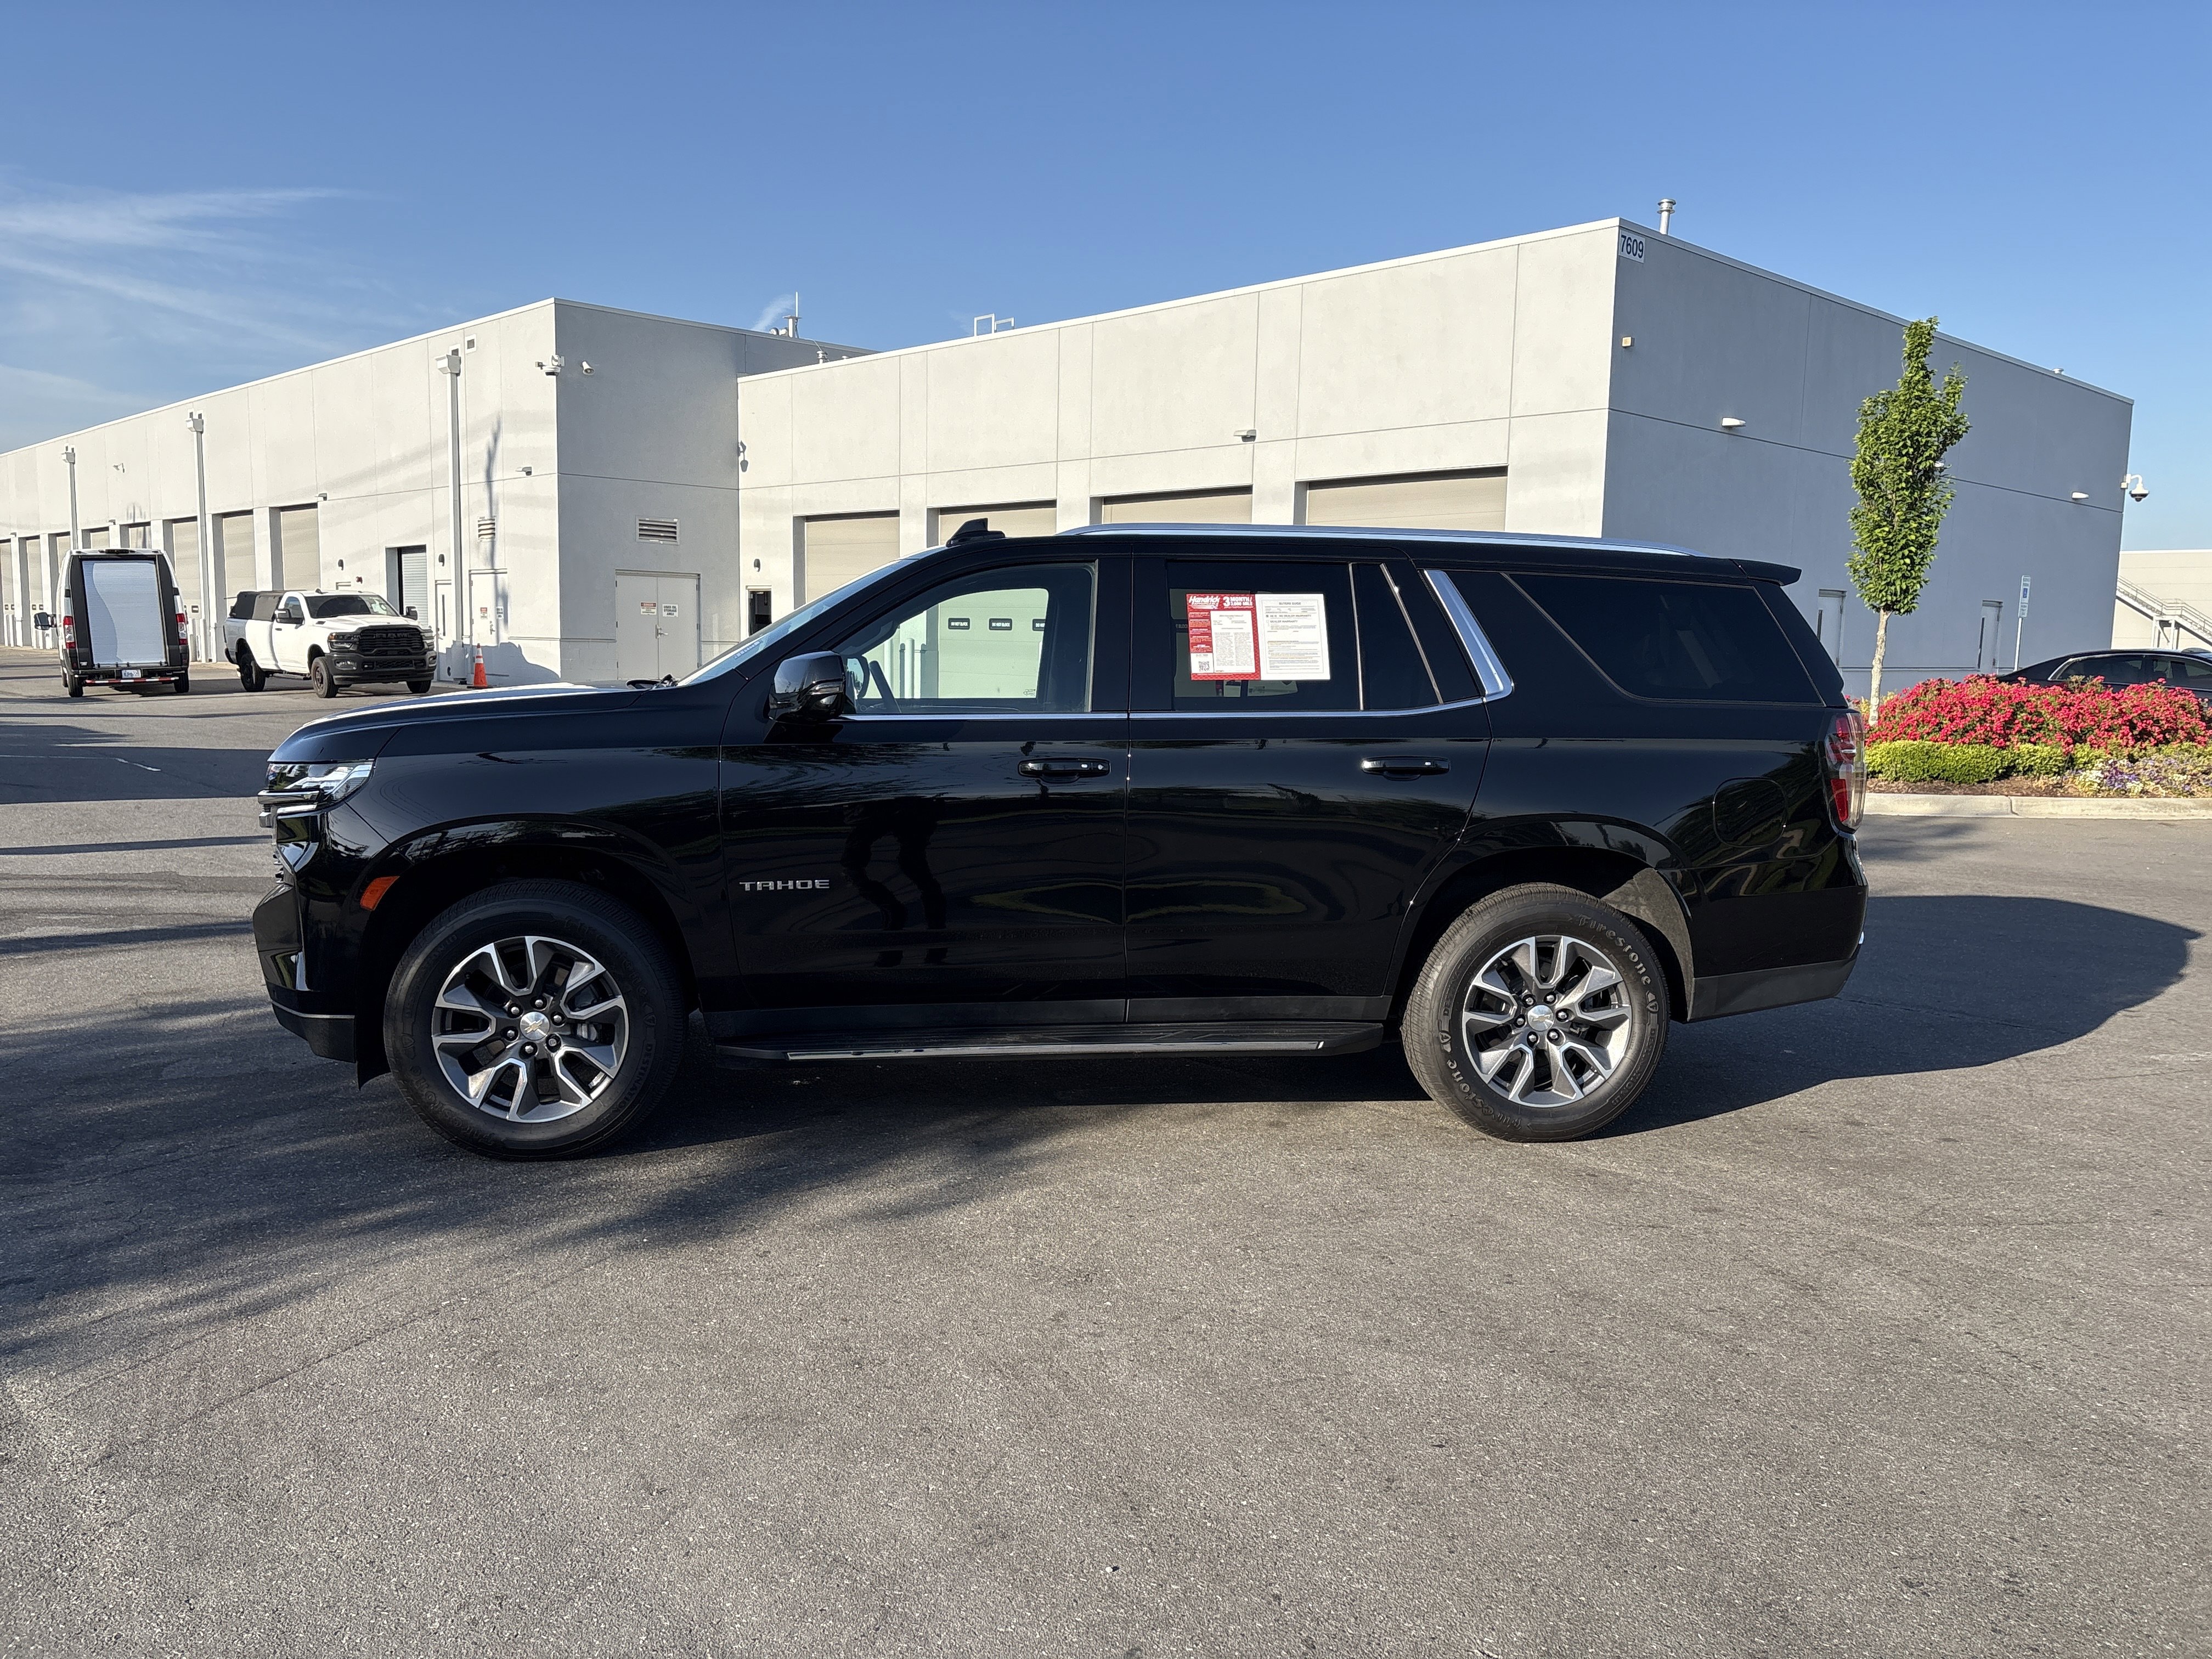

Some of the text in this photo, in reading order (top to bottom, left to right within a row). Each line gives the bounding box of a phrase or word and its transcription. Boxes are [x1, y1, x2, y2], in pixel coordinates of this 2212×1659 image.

[1621, 234, 1644, 258] 7609
[1189, 595, 1221, 605] Hendrick
[1223, 596, 1230, 607] 3
[739, 879, 830, 891] TAHOE
[1578, 913, 1651, 985] Firestone
[610, 1043, 653, 1113] DESTINATION
[1446, 1059, 1521, 1131] Firestone
